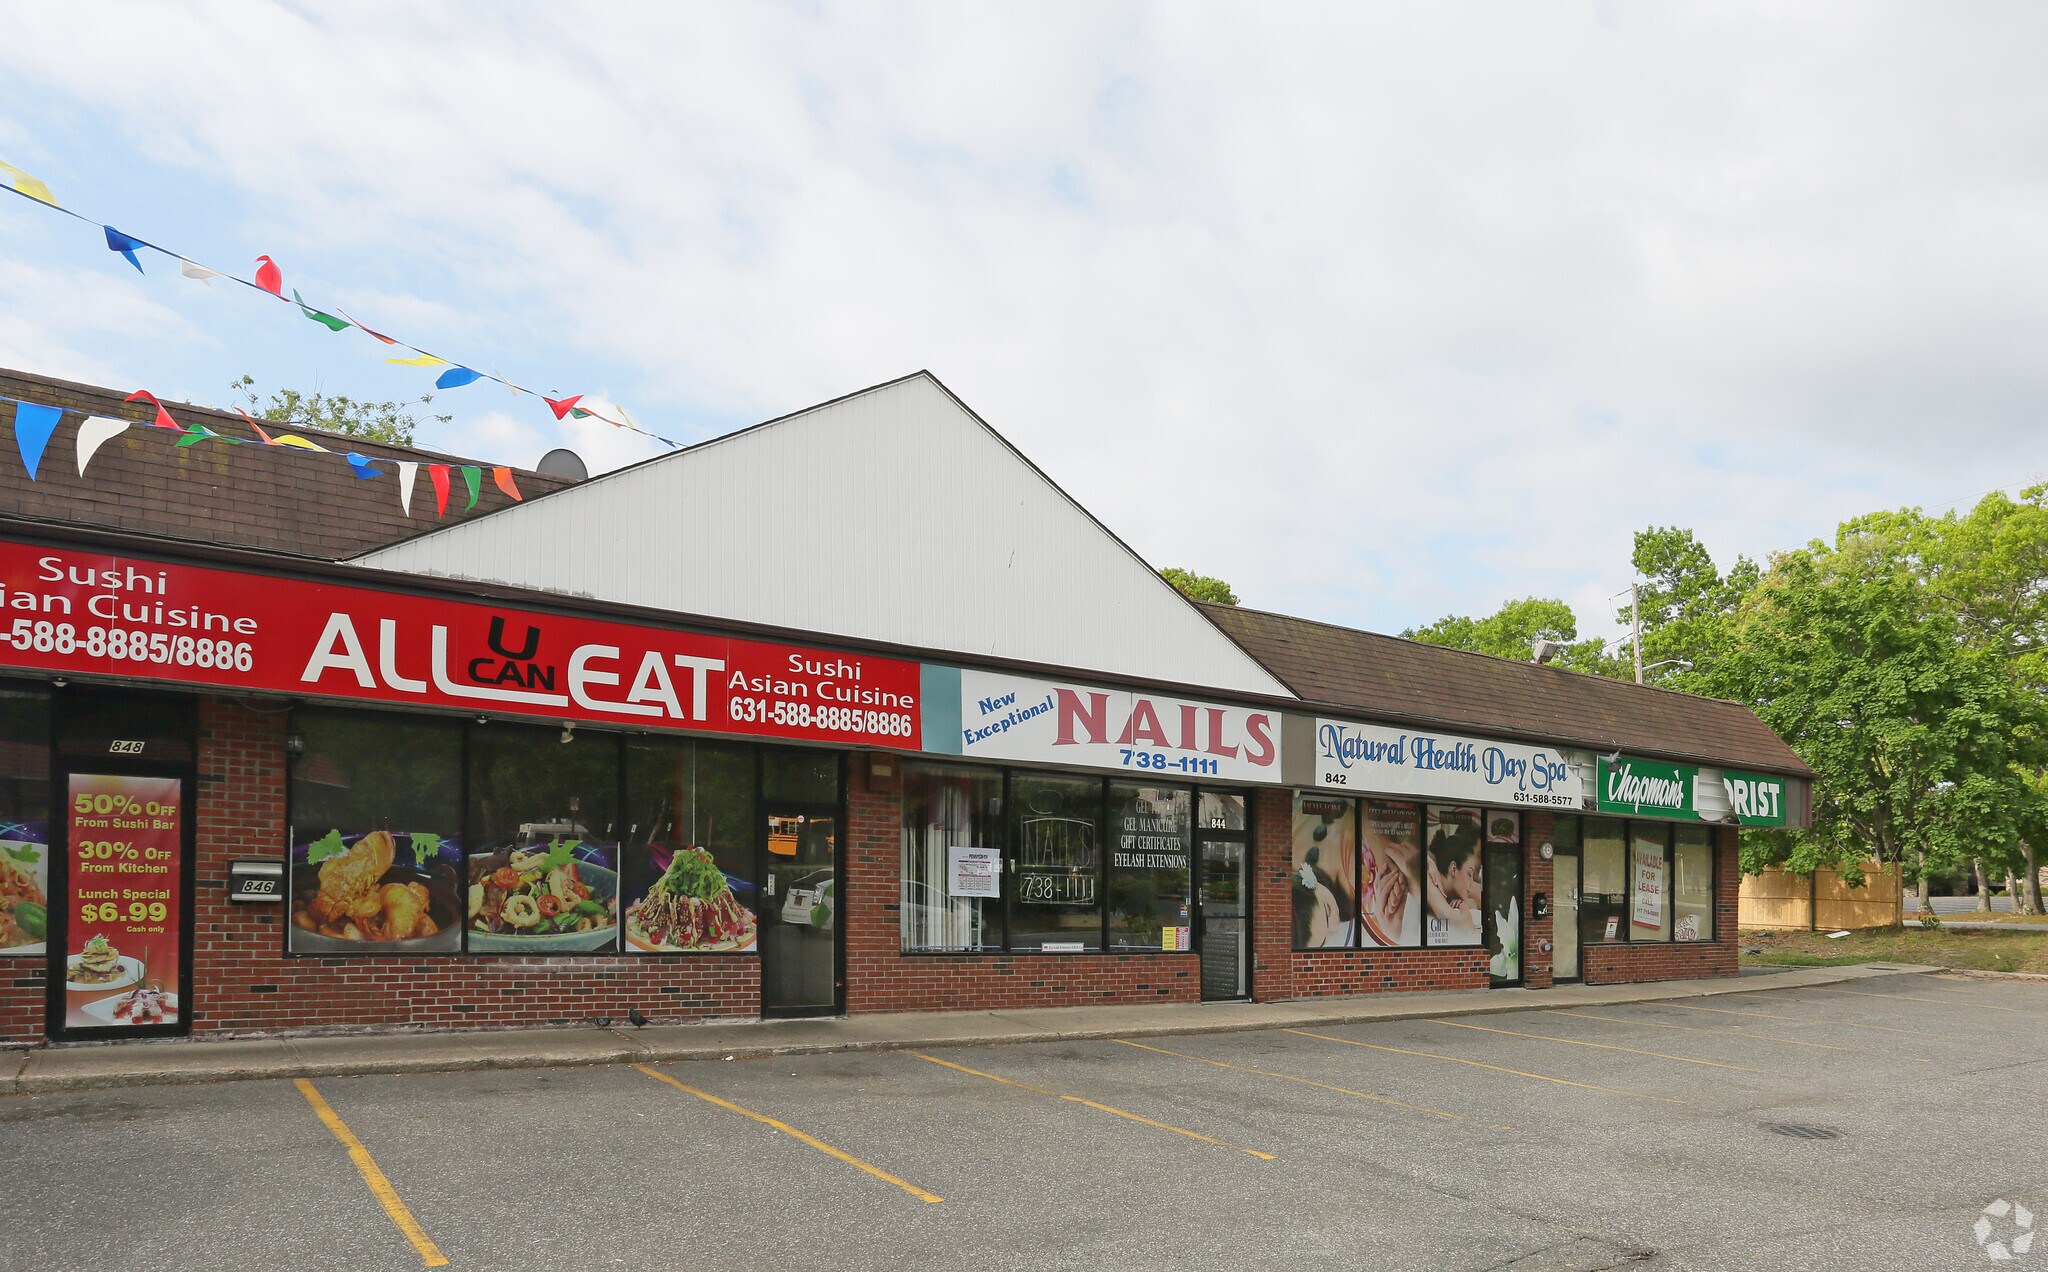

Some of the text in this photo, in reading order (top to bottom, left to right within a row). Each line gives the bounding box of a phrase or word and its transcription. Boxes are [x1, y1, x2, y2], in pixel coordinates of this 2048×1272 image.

[38, 556, 167, 595] Sushi
[88, 594, 258, 635] Cuisine
[488, 615, 541, 661] U
[300, 612, 568, 707] ALL
[788, 653, 861, 680] Sushi
[468, 658, 555, 691] CAN
[567, 644, 725, 720] EAT
[728, 671, 914, 709] Asian Cuisine
[978, 690, 1016, 716] New
[730, 697, 912, 738] 631-588-8885/8886
[963, 695, 1055, 746] Exceptional
[1052, 687, 1276, 767] NAILS
[111, 740, 143, 753] 848
[1119, 749, 1218, 775] 738-1111
[1319, 723, 1567, 792] Natural Health Day Spa
[1325, 772, 1347, 785] 842
[74, 793, 142, 816] 50%
[1513, 792, 1573, 806] 631-588-5577
[75, 817, 174, 830] From Sushi Bar
[1124, 817, 1137, 831] GEL
[1211, 818, 1226, 829] 844
[78, 841, 139, 860] 30%
[1121, 835, 1180, 851] GIFT CERTIFICATES
[81, 862, 168, 874] From Kitchen
[1114, 853, 1187, 869] EYELASH EXTENSIONS
[1636, 852, 1663, 870] AVAILABLE
[1641, 870, 1656, 881] FOR
[78, 888, 170, 902] Lunch Special
[244, 880, 273, 892] 846
[1637, 881, 1660, 895] LEASE
[1641, 898, 1654, 907] CALL
[81, 902, 167, 924] $6.99
[126, 925, 165, 934] Cash only
